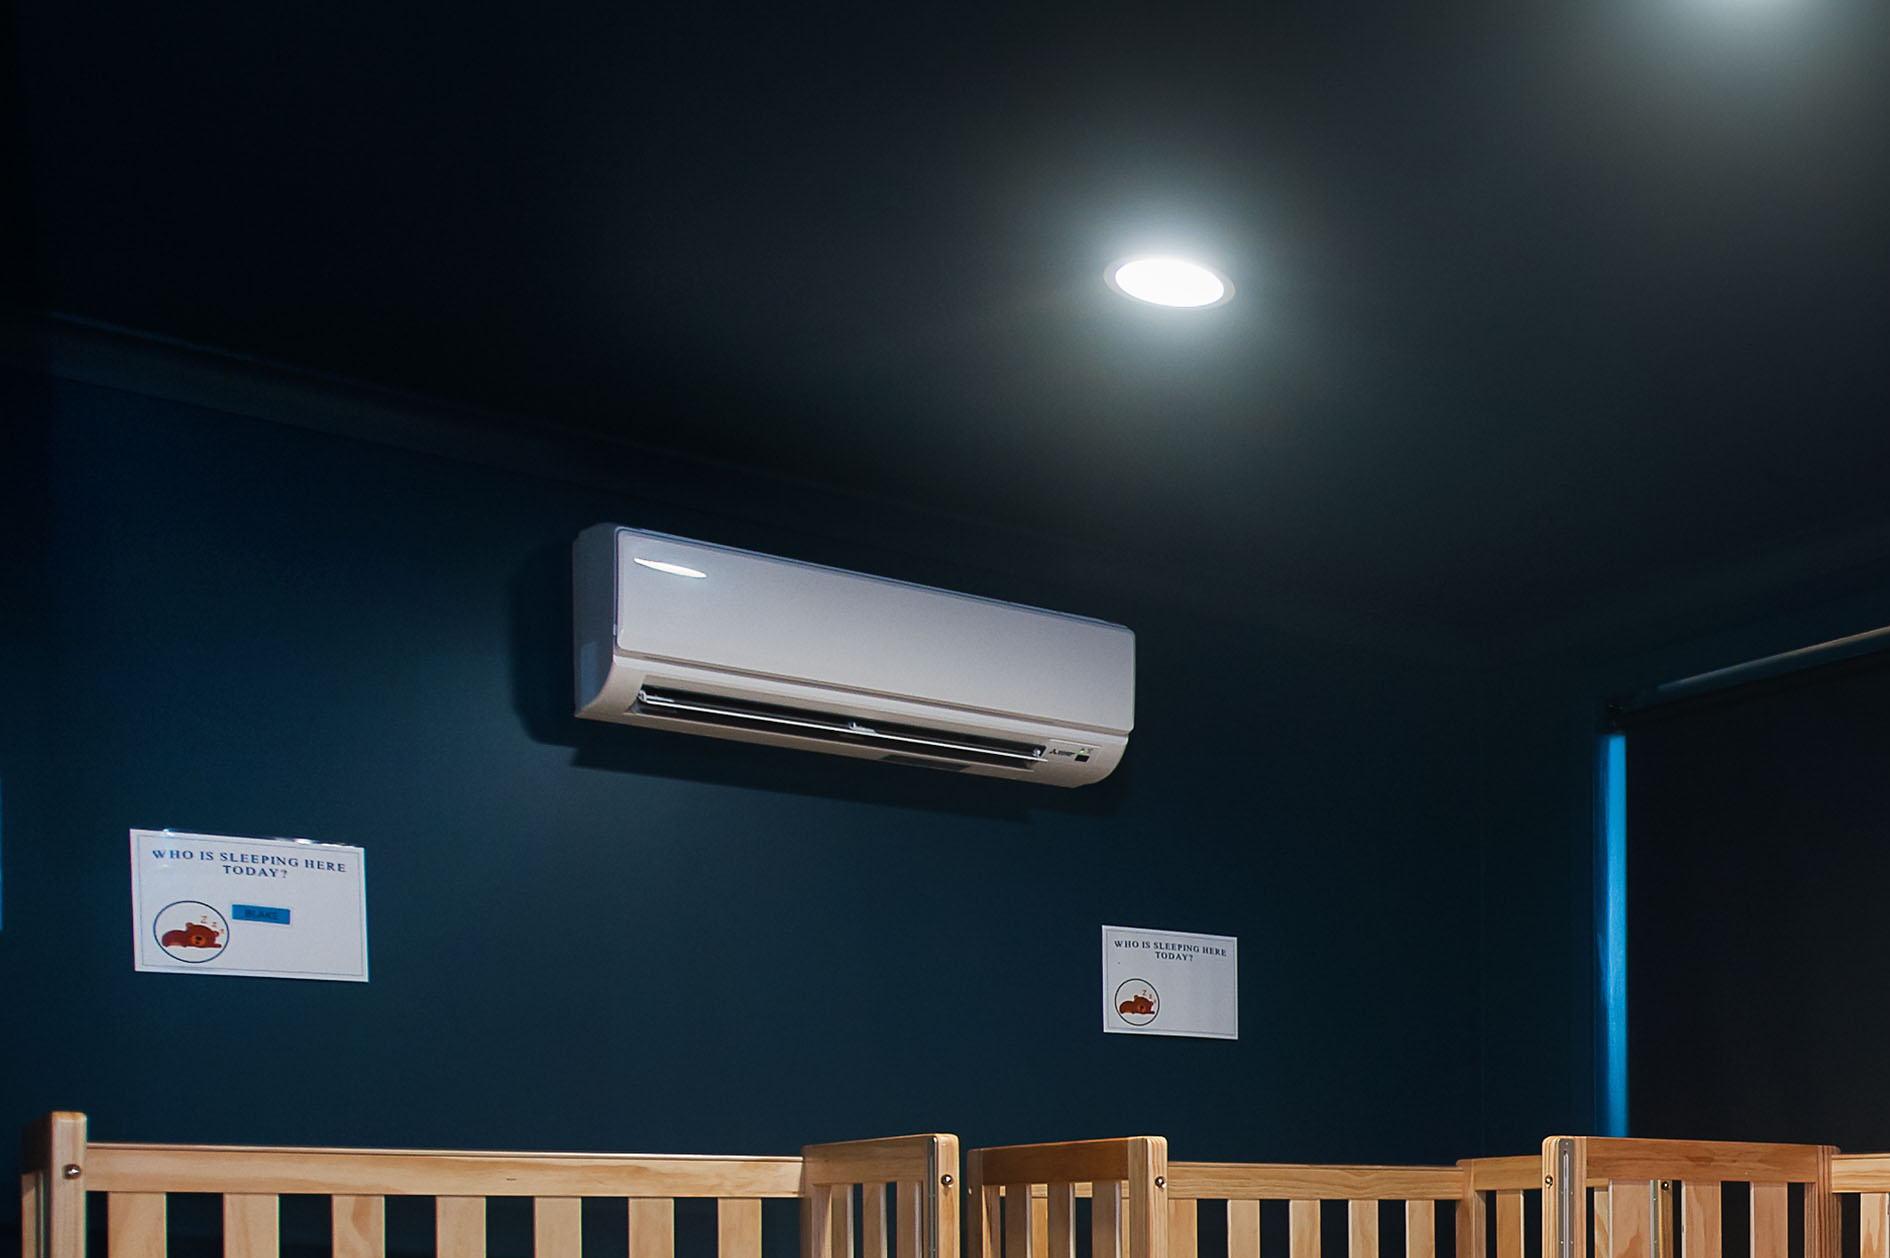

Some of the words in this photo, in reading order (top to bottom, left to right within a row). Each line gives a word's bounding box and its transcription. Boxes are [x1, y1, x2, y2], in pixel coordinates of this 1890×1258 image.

[152, 849, 194, 860] WHO
[200, 850, 214, 861] IS
[220, 852, 299, 867] SLEEPING
[304, 859, 347, 873] HERE
[223, 865, 288, 879] TODAY?
[1114, 940, 1139, 949] WHO
[1142, 941, 1151, 949] IS
[1153, 942, 1200, 953] SLEEPING
[1202, 947, 1227, 957] HERE
[1155, 951, 1194, 962] TODAY?
